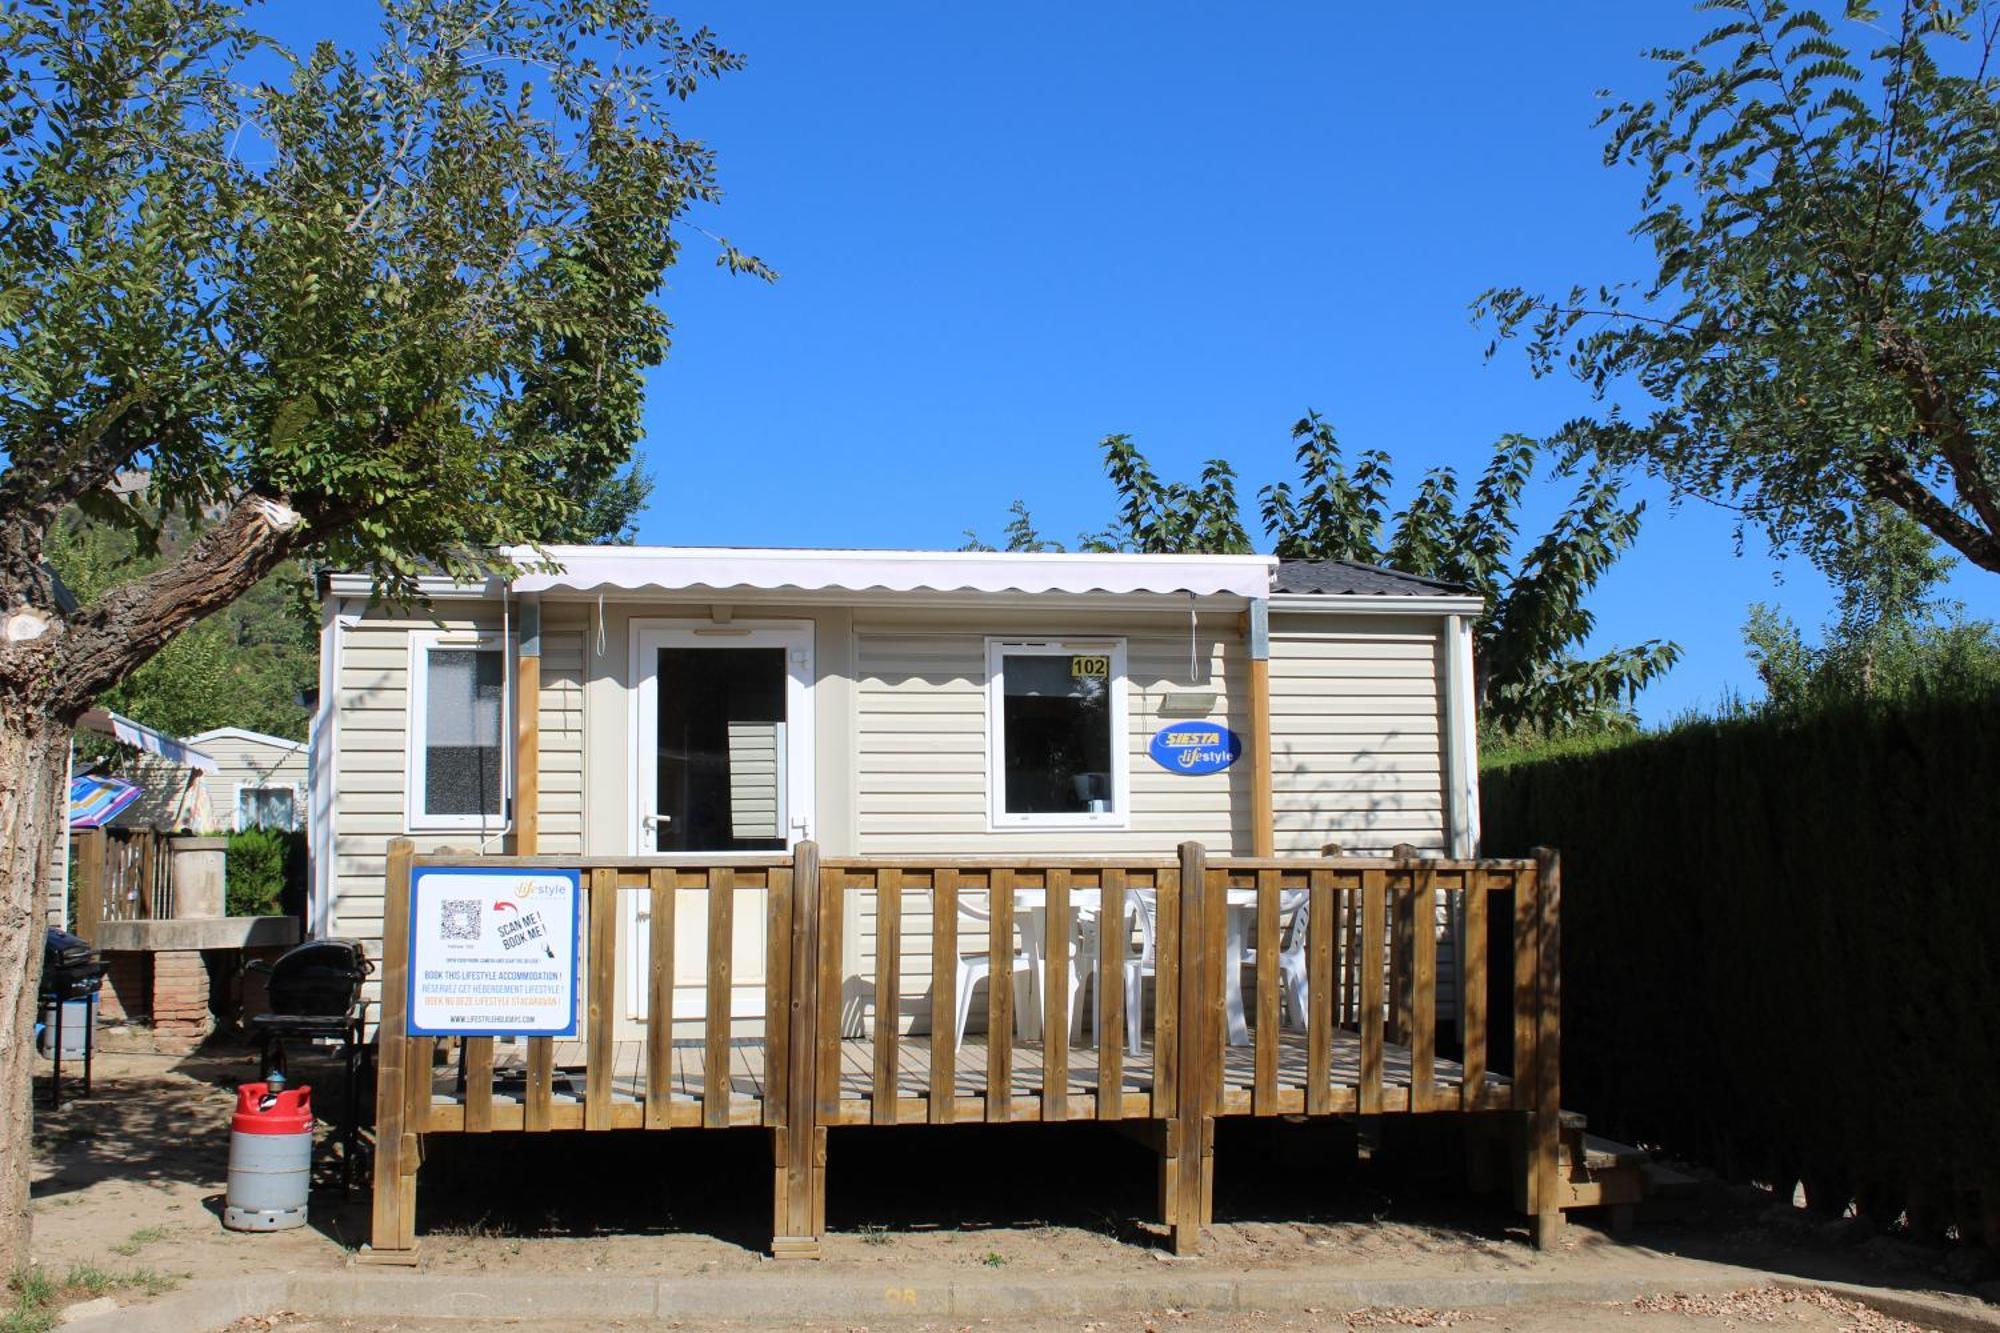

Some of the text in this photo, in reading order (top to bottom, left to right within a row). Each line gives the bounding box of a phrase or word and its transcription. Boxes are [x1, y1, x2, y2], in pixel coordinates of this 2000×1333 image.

[1074, 659, 1105, 674] 102
[1166, 732, 1220, 745] SIESTA
[497, 920, 522, 938] SCAN
[522, 913, 537, 928] ME
[502, 932, 527, 950] BOOK
[527, 926, 543, 941] ME
[424, 970, 442, 981] BOOK
[444, 970, 461, 981] THIS
[462, 971, 497, 981] LIFESTYLE
[498, 971, 558, 981] ACCOMMODATION
[525, 985, 560, 994] LIFESTYLE
